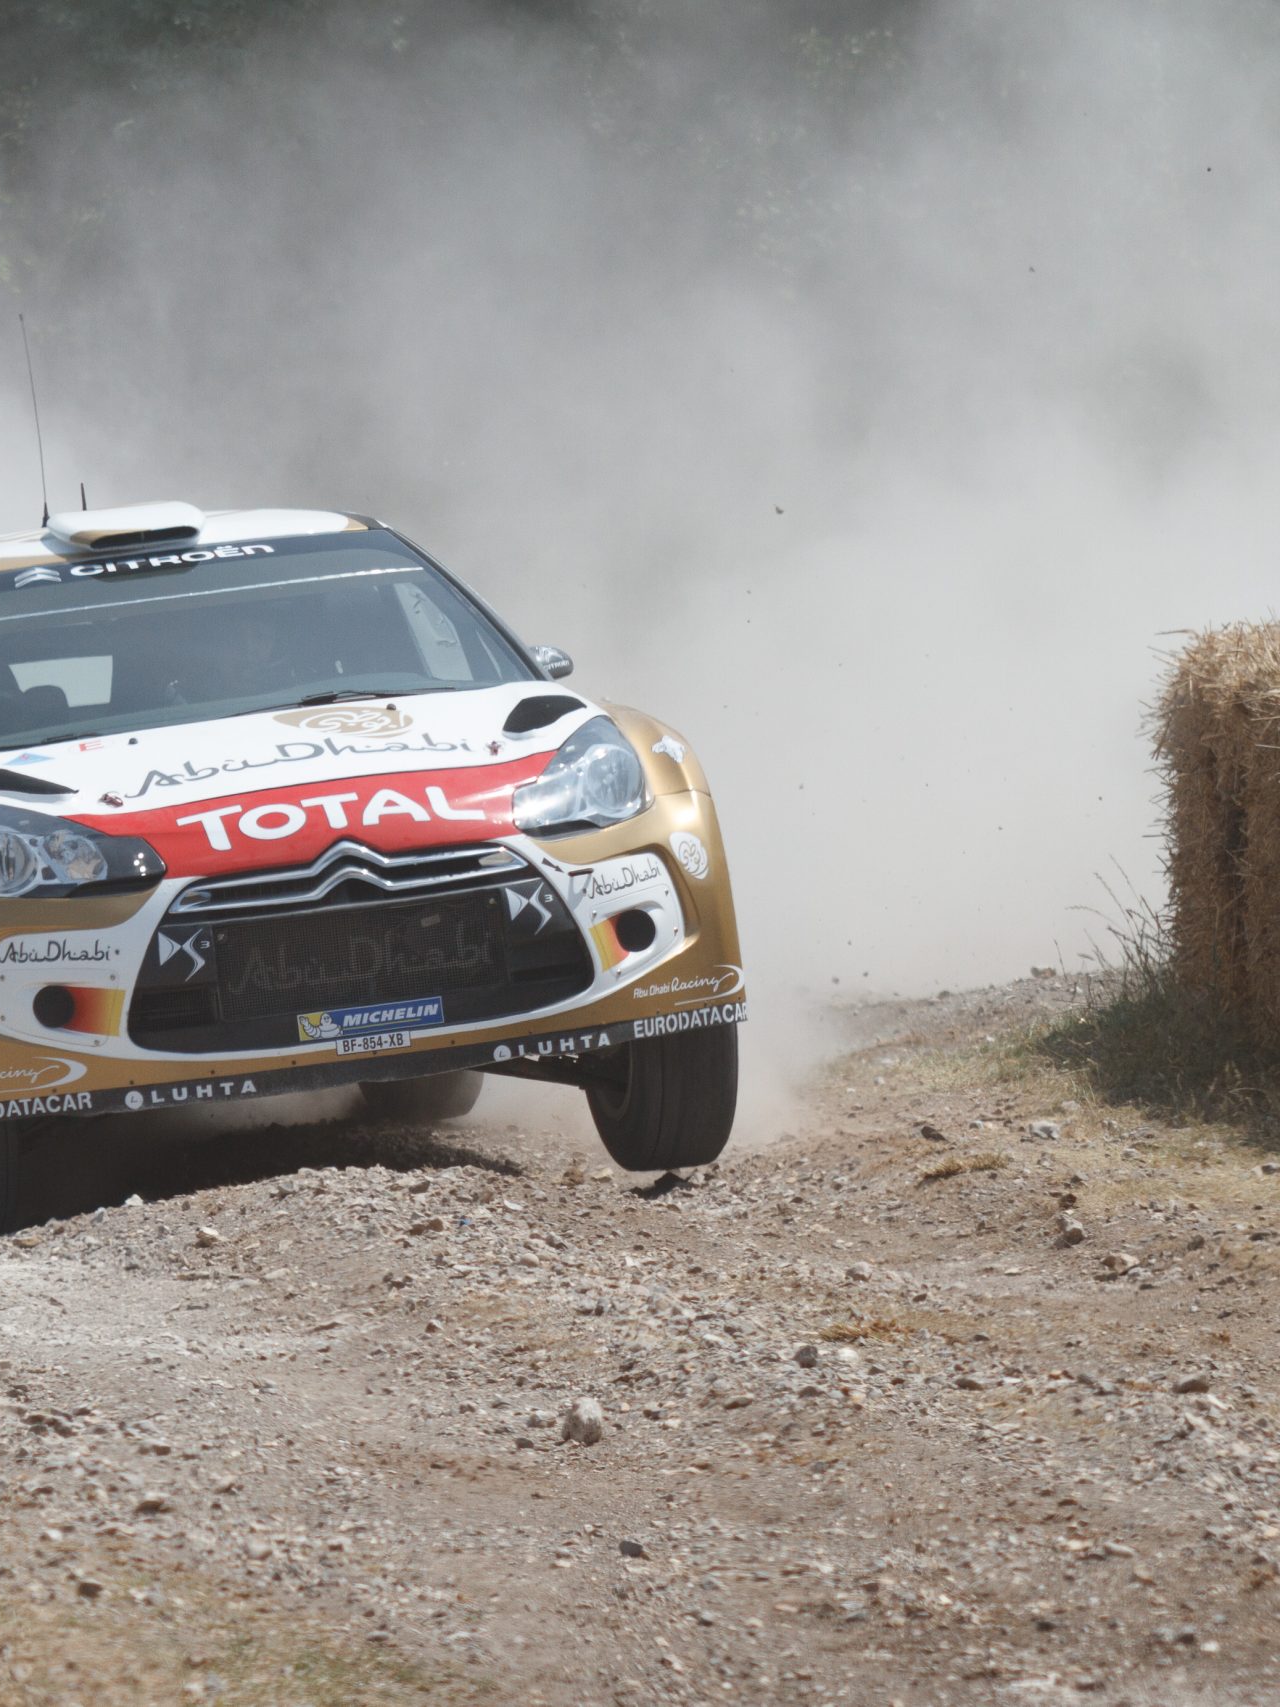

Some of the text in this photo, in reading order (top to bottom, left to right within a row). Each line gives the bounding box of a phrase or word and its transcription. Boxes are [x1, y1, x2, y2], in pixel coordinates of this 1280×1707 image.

[176, 786, 486, 851] TOTAL
[634, 971, 734, 999] Abu Dhabi Racing
[343, 1003, 439, 1027] MICHELIN
[342, 1032, 404, 1053] BF-854-XB
[150, 1079, 258, 1104] LUHTA
